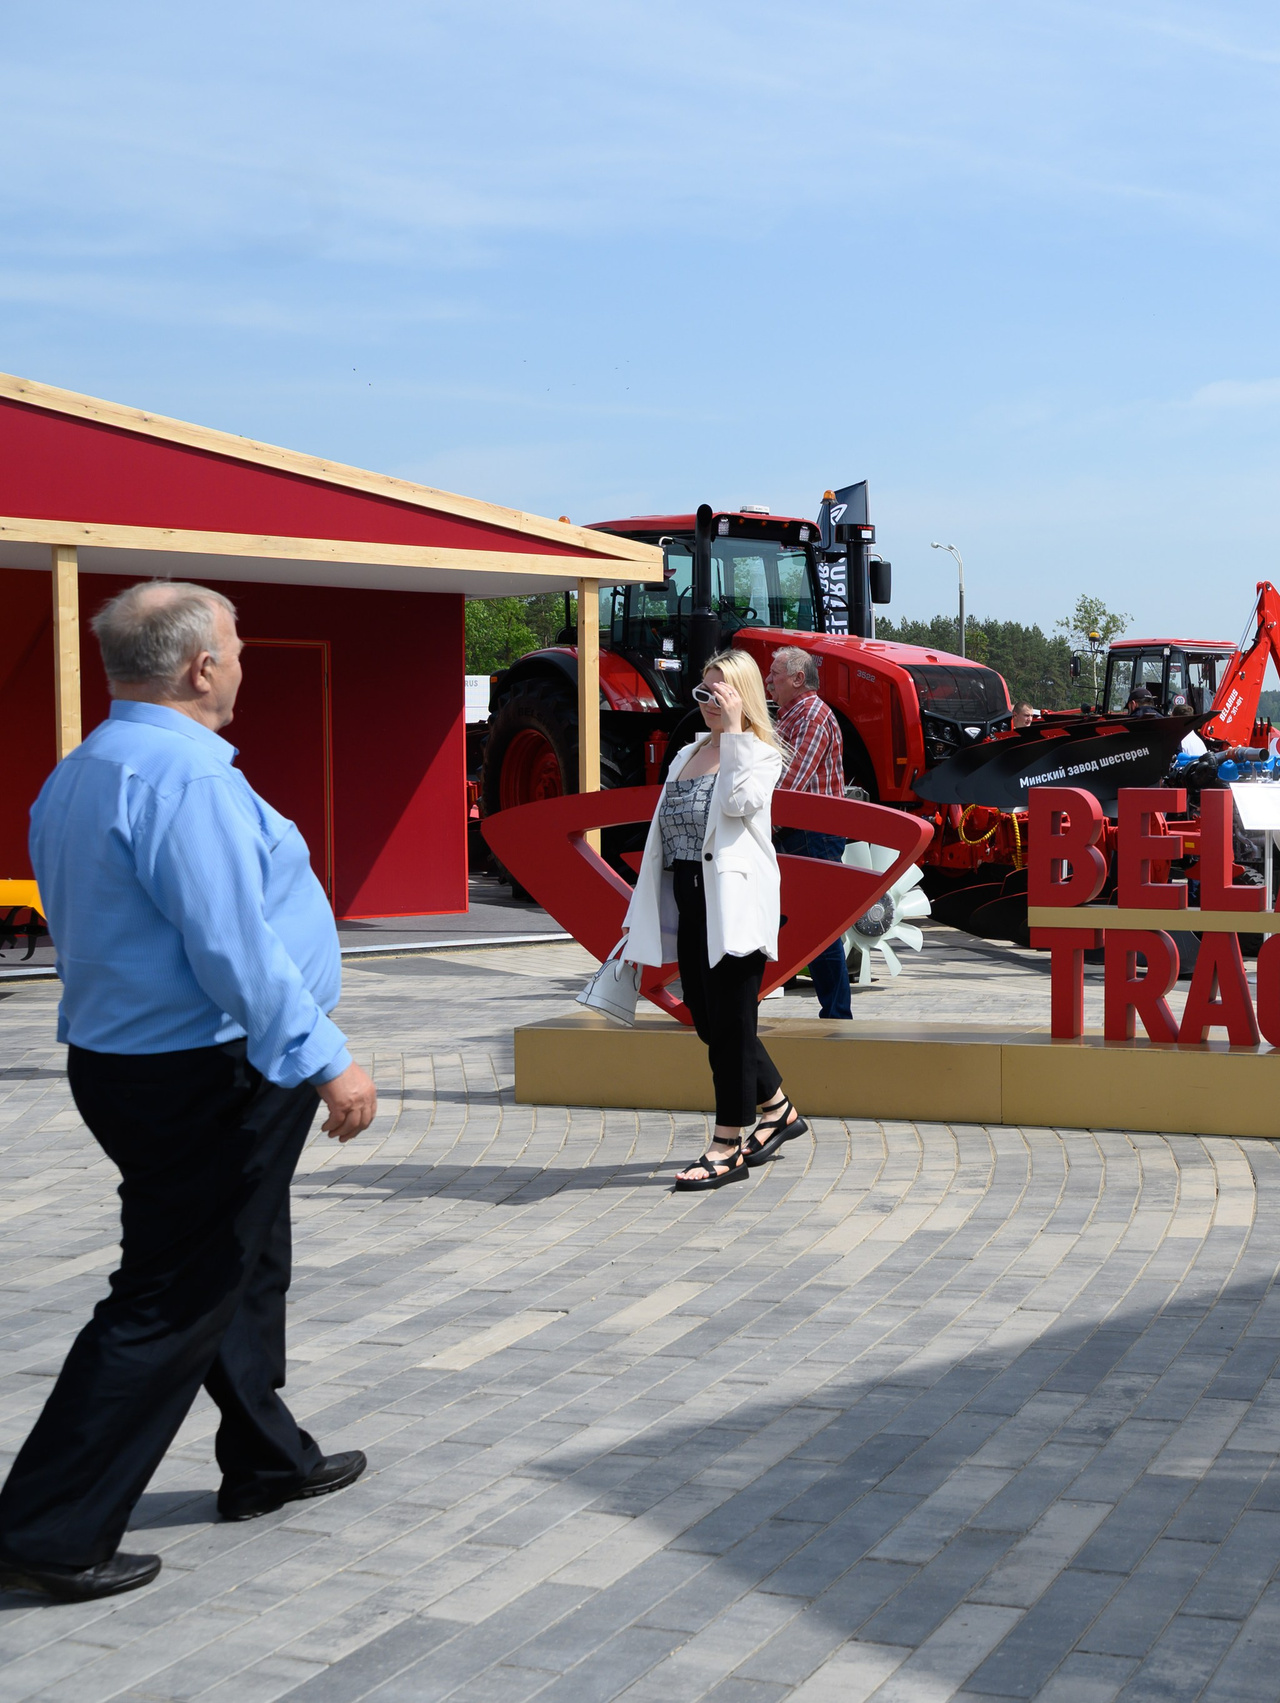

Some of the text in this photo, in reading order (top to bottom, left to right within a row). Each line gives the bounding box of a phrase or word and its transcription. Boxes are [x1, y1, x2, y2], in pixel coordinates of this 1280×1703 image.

[857, 669, 876, 683] 3522
[1219, 688, 1239, 722] BELARUS
[1020, 747, 1150, 788] Минский завод шестерен
